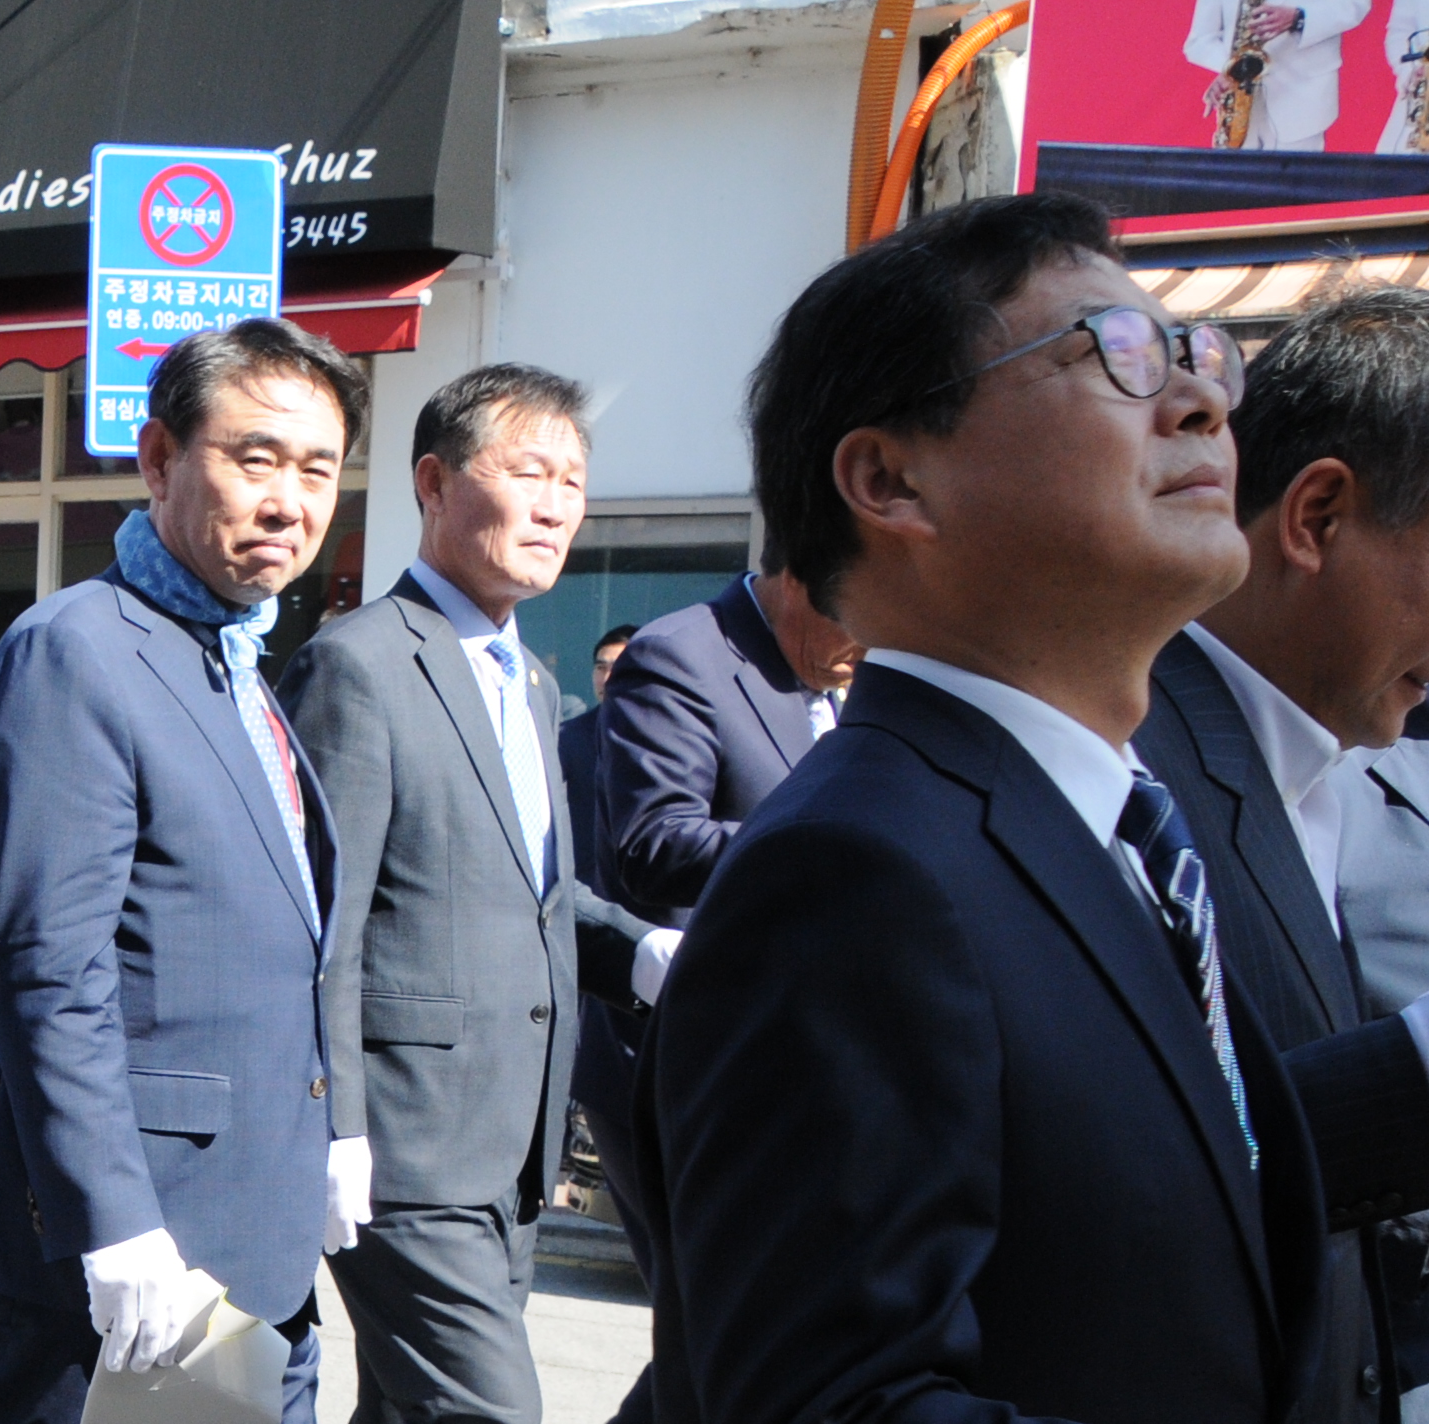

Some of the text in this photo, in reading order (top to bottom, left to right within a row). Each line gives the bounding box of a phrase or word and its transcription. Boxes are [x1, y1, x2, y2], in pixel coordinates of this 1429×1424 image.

[151, 205, 221, 225] 주정차금지
[104, 278, 269, 308] 주정차금지시간
[152, 310, 264, 331] 09:00~18:
